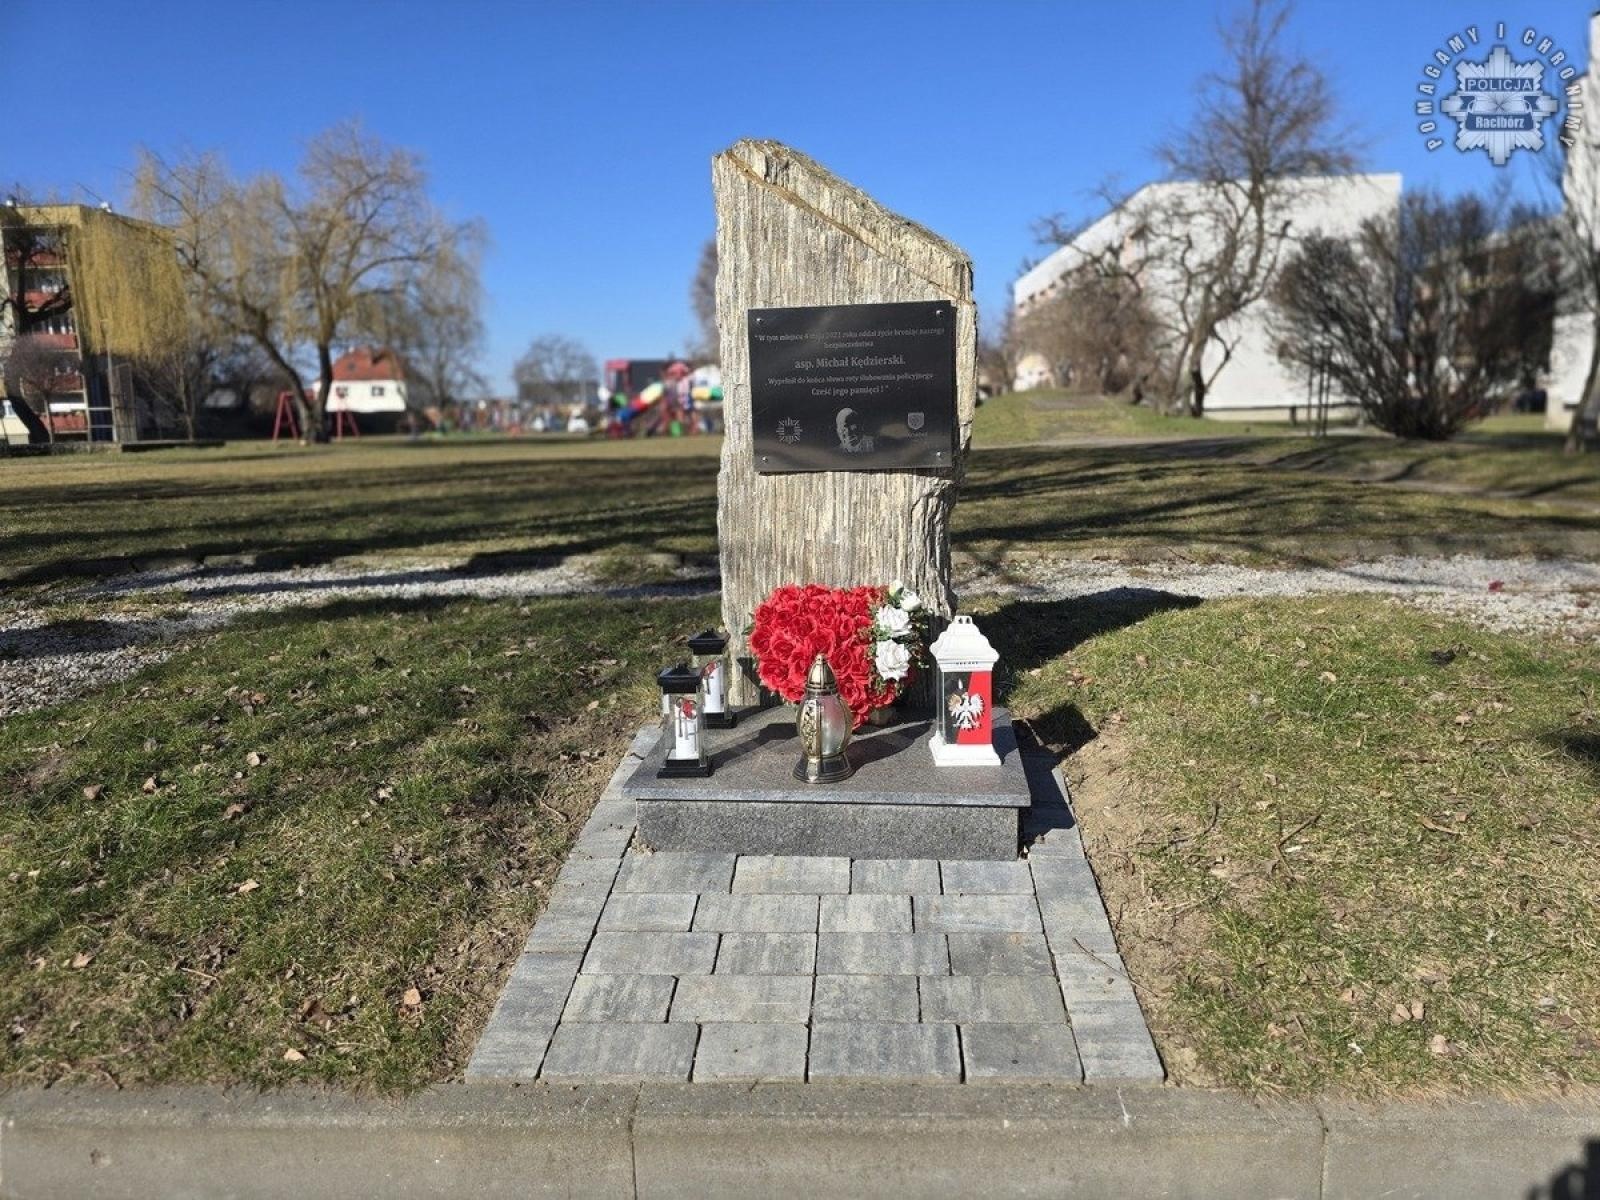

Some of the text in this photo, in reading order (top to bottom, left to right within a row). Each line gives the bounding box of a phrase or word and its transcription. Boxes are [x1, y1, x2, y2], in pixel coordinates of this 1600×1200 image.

[795, 354, 906, 370] asp. Michał Kędzierski.
